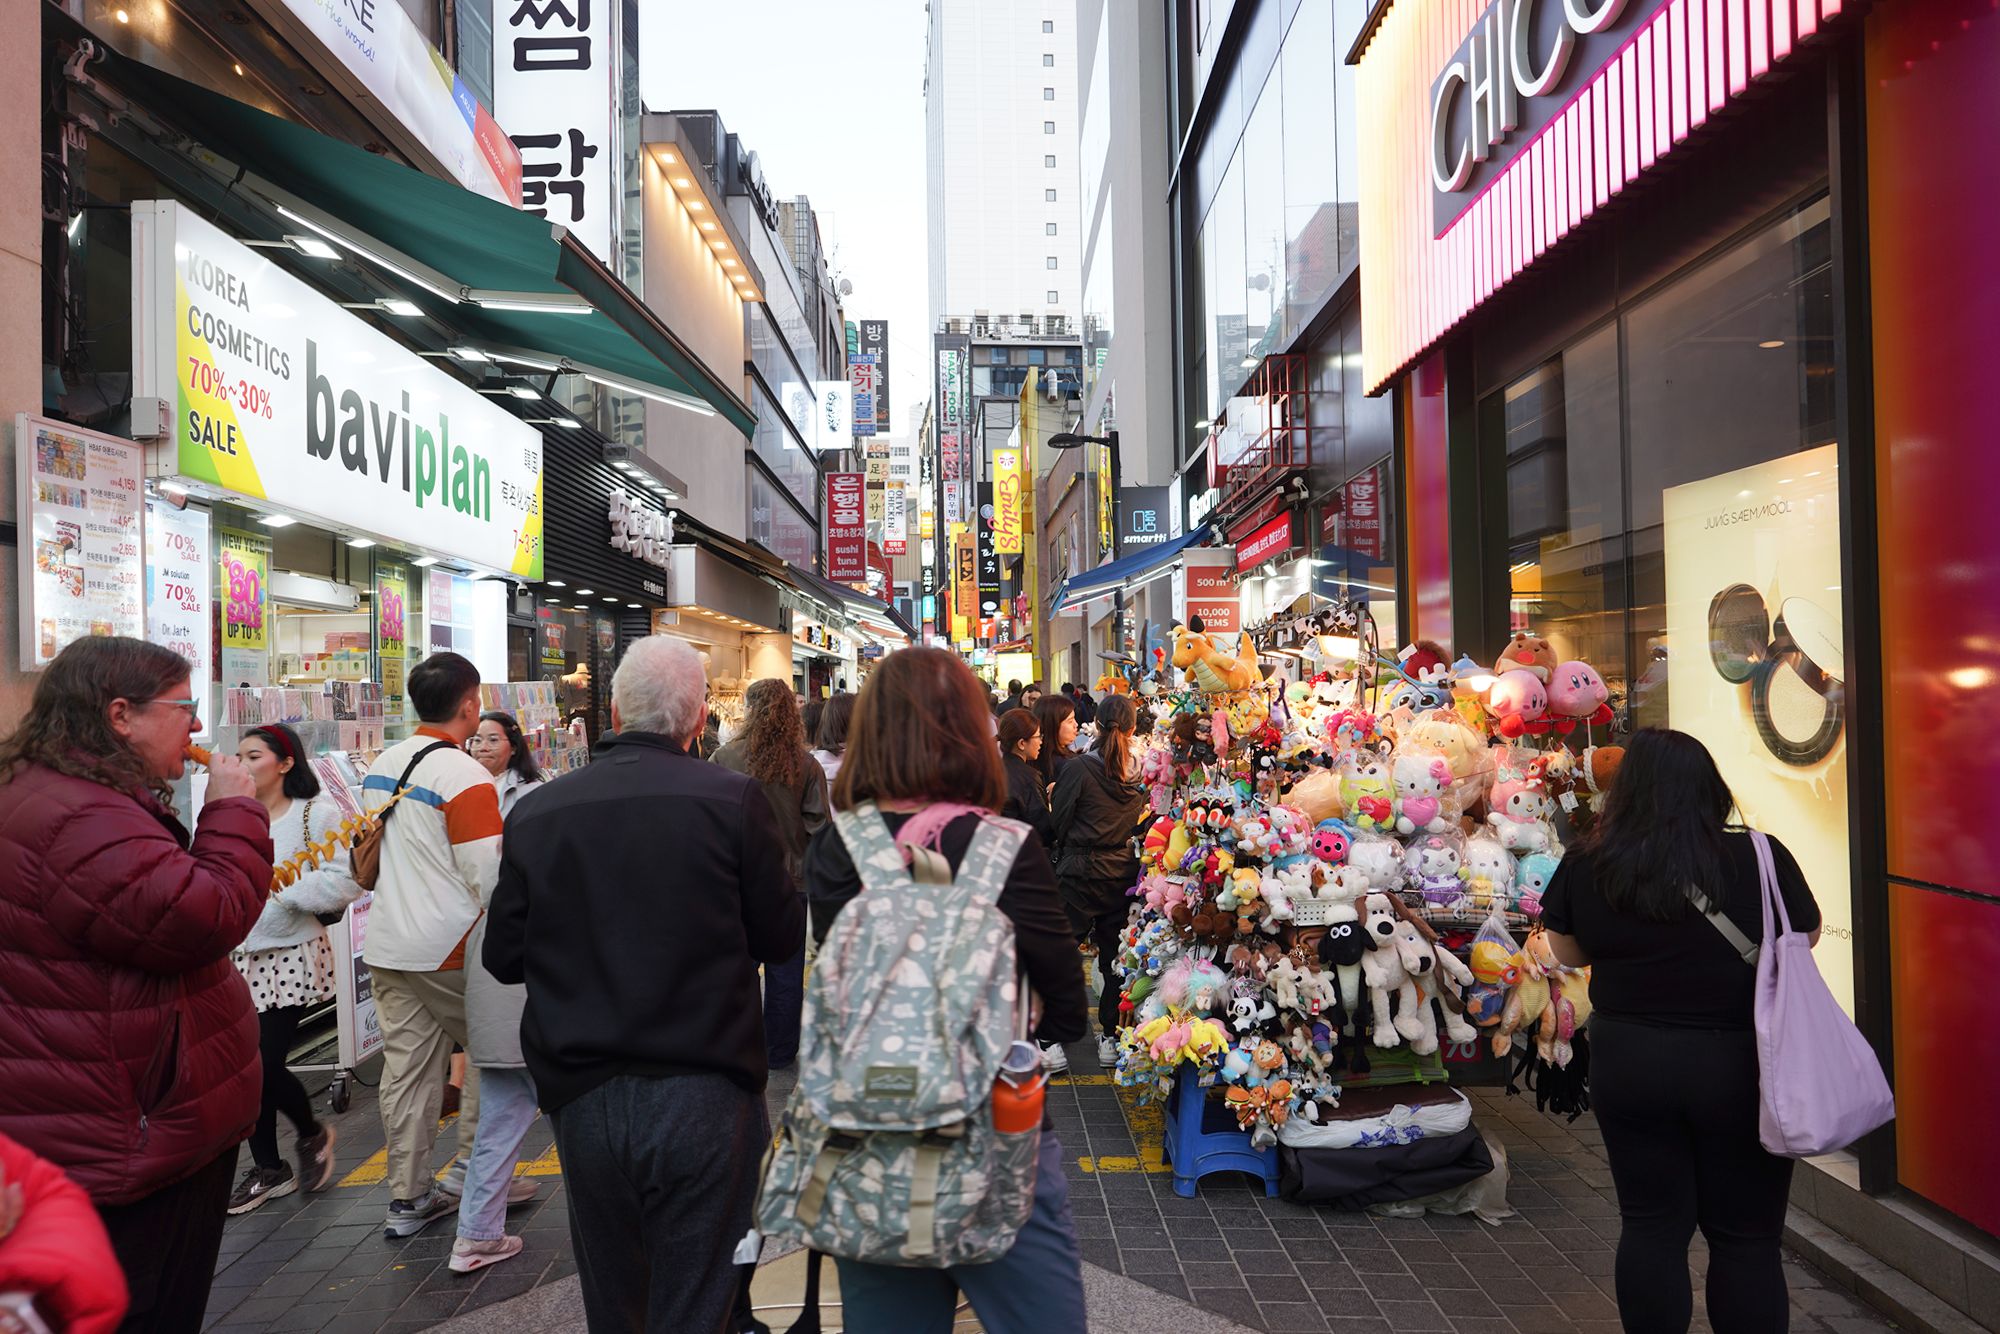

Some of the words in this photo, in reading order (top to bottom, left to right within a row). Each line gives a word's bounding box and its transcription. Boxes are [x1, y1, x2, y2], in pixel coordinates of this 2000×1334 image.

[188, 250, 249, 312] KOREA
[188, 304, 290, 381] COSMETICS
[189, 355, 272, 420] 70%~30%
[948, 391, 956, 422] FOOD
[189, 410, 236, 456] SALE
[306, 337, 490, 523] baviplan
[1704, 506, 1730, 530] JUNG
[1731, 507, 1758, 525] SAEM
[1758, 500, 1792, 519] MOOL
[165, 532, 195, 552] 70%
[222, 532, 242, 550] NEW
[245, 541, 265, 556] YEAR
[1124, 533, 1167, 543] smartti
[181, 551, 200, 562] SALE
[835, 544, 858, 554] sushi
[837, 557, 857, 565] tuna
[170, 569, 190, 580] solution
[831, 569, 863, 577] salmon
[229, 560, 261, 607] 80
[1197, 578, 1215, 587] 500
[165, 583, 195, 602] 70%
[181, 601, 200, 612] SALE
[227, 602, 262, 629] SALE
[1198, 608, 1230, 618] 10,000
[227, 623, 239, 638] UP
[241, 625, 252, 640] TO
[1202, 618, 1229, 627] TEMS
[381, 638, 389, 650] UP
